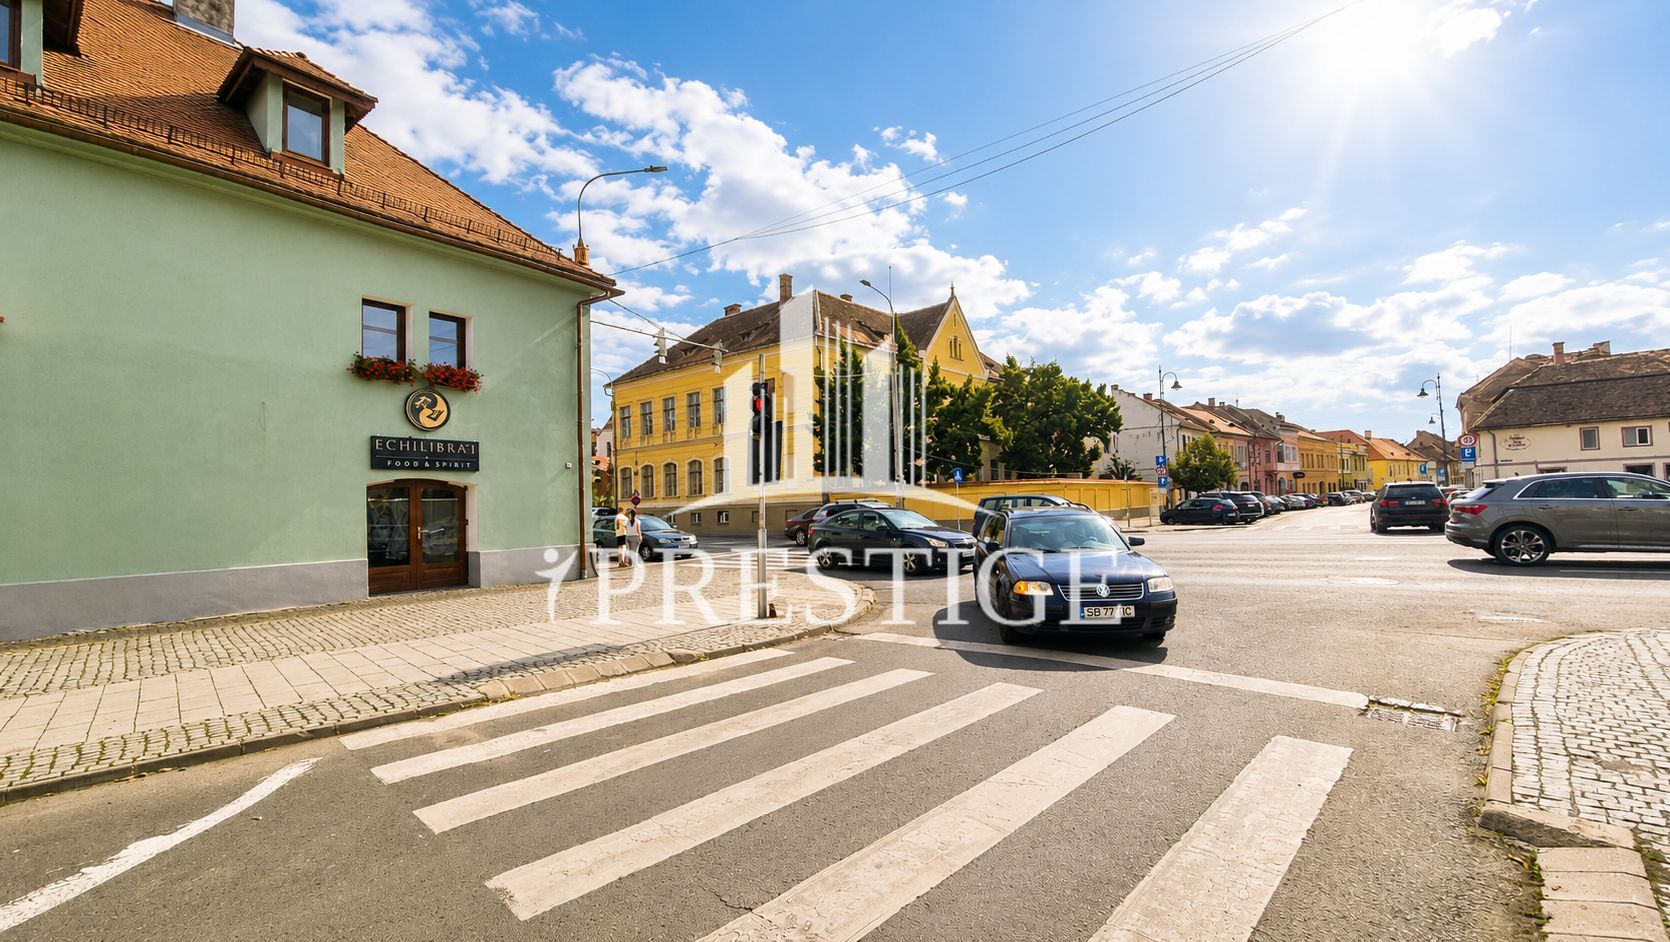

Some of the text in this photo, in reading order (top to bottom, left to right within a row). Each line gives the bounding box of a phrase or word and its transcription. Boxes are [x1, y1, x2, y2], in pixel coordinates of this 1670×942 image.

[1086, 606, 1131, 617] SB 77 IC
